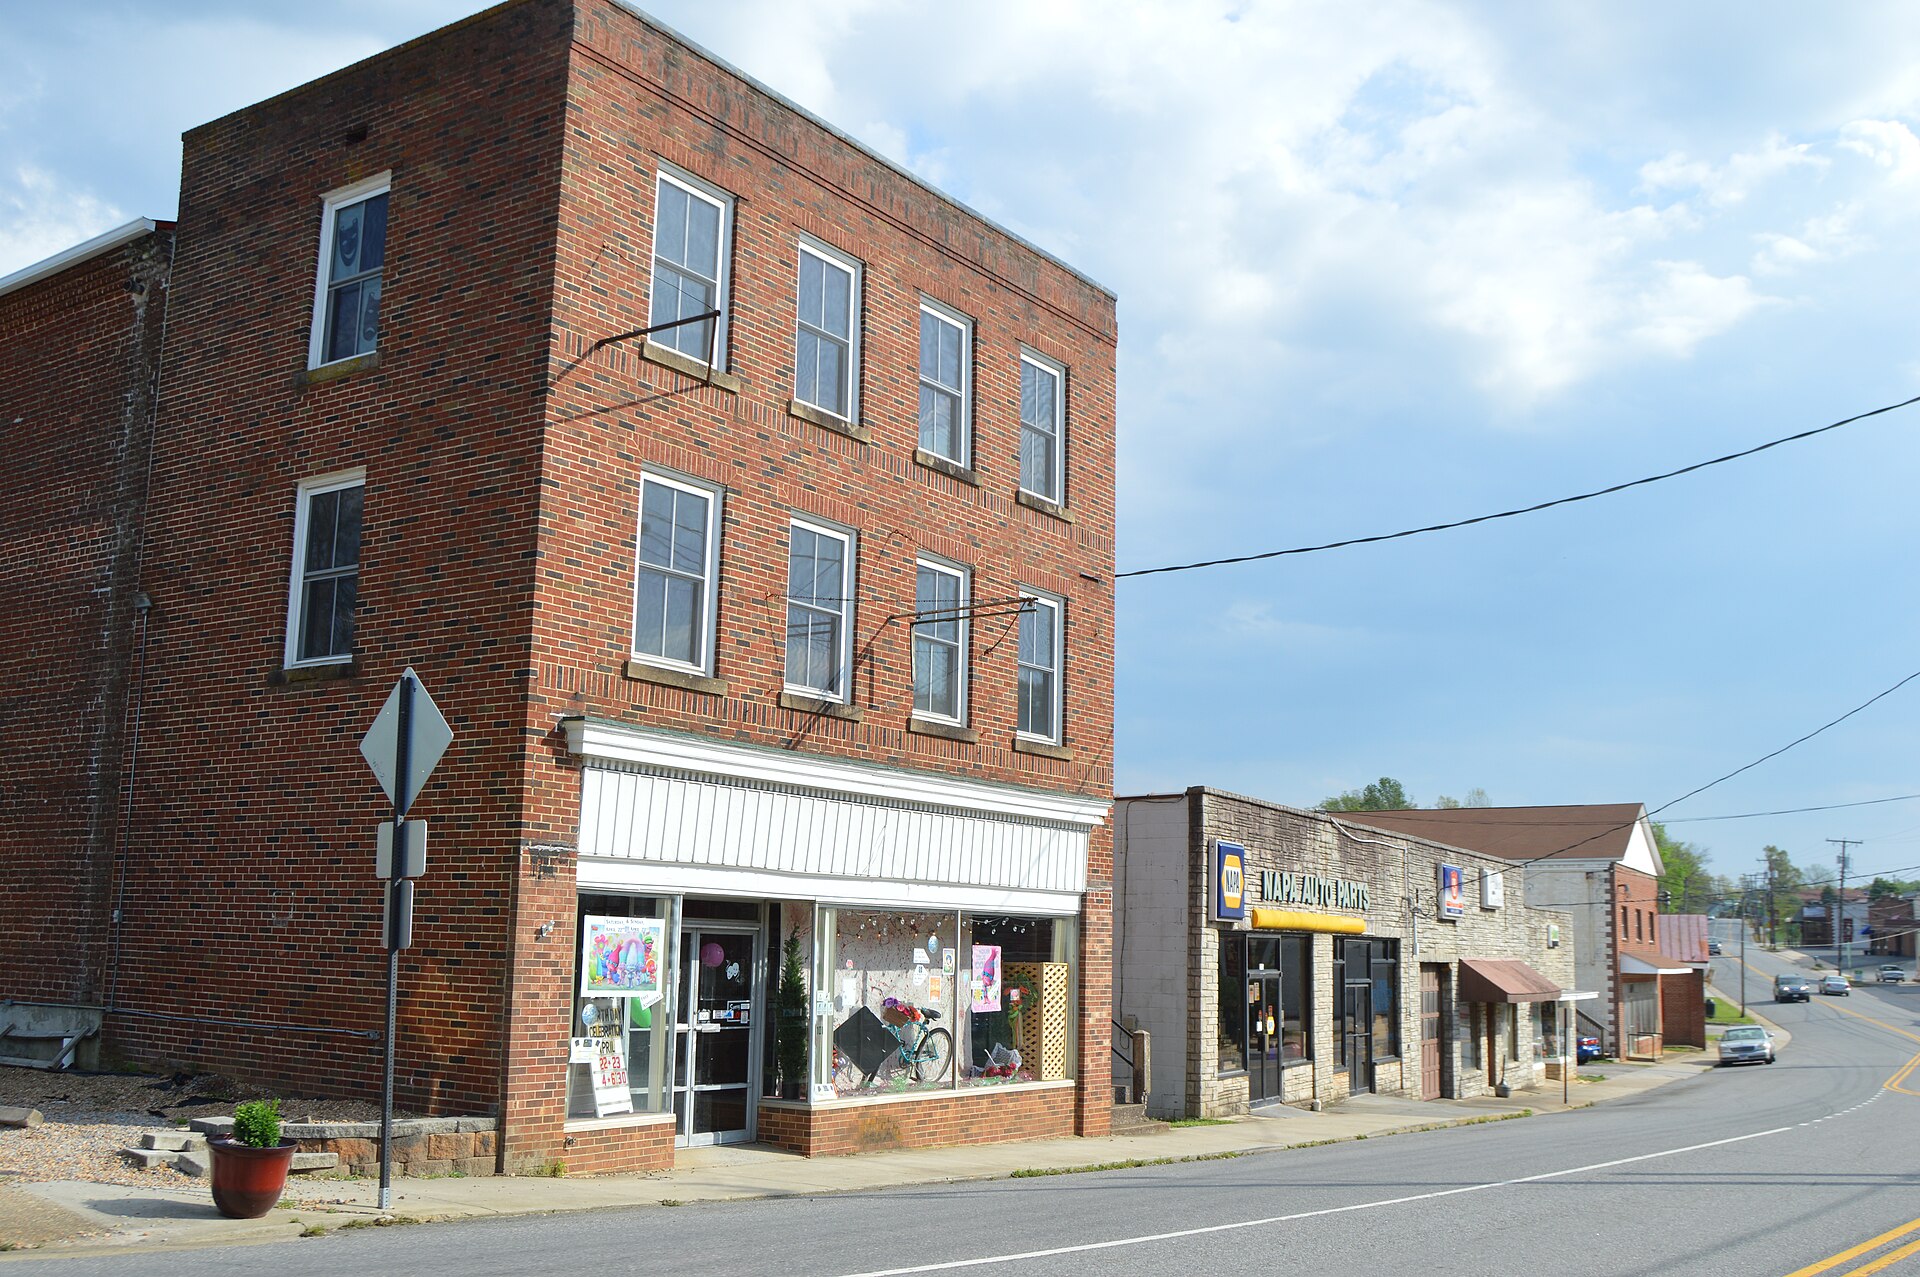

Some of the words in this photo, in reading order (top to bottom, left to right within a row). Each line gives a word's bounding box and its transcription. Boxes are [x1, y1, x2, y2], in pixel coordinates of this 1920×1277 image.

[1225, 869, 1240, 893] NAPA
[1261, 869, 1298, 902] NAPA
[1302, 875, 1333, 906] AUTO
[1336, 879, 1371, 911] PARTS
[597, 1008, 622, 1021] RTHDAY
[590, 1025, 623, 1038] CELEBRATION
